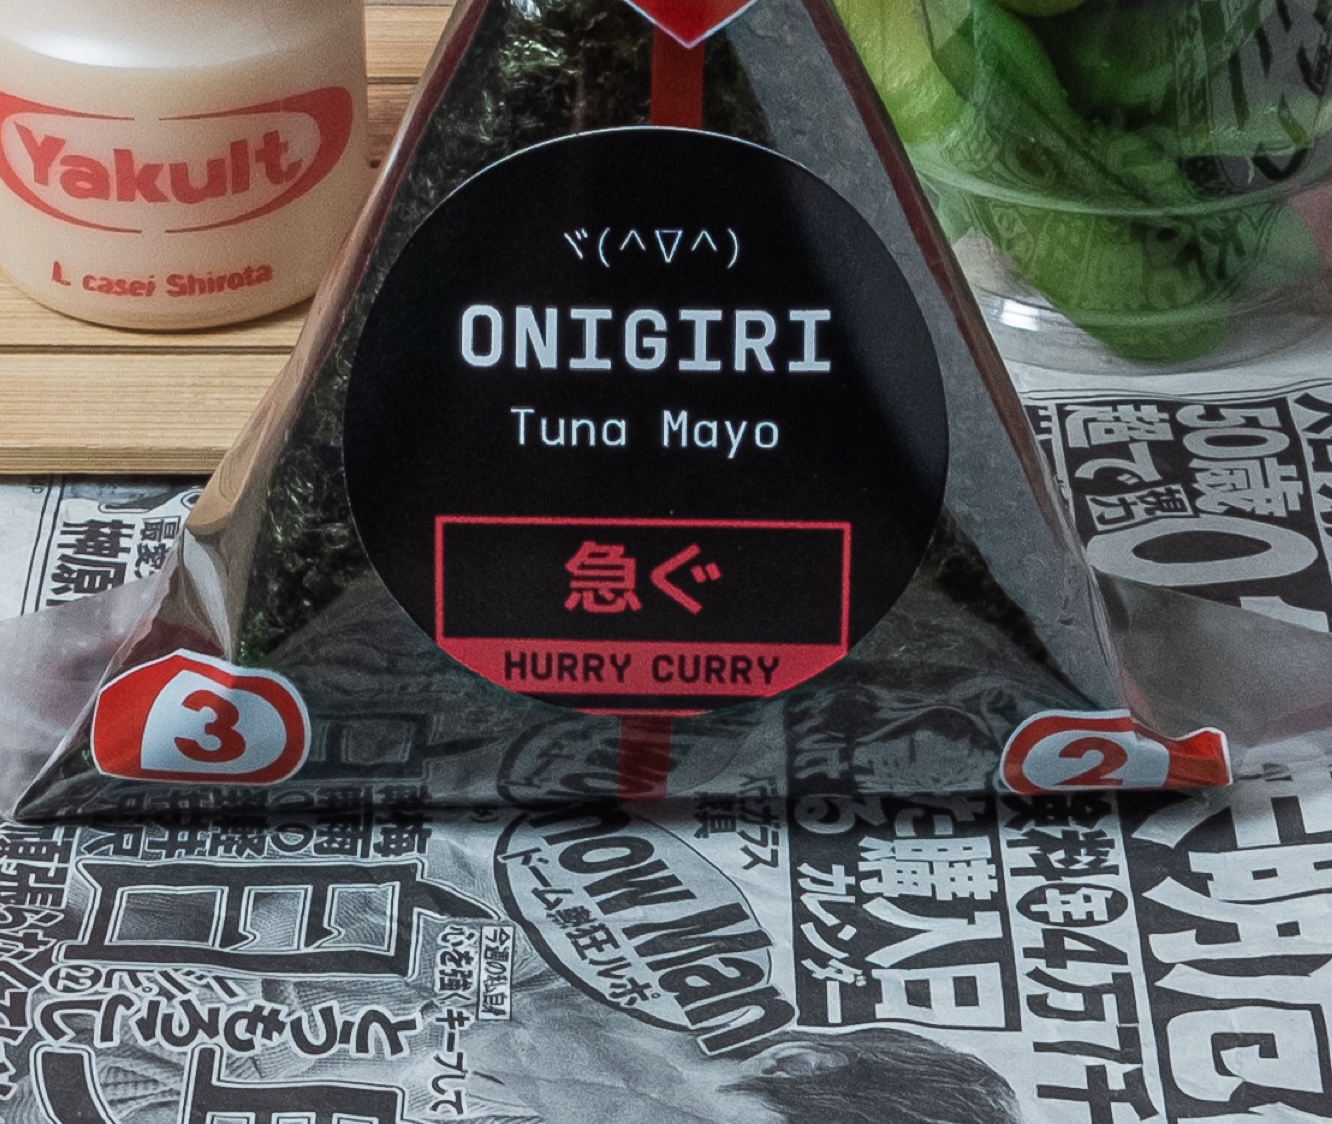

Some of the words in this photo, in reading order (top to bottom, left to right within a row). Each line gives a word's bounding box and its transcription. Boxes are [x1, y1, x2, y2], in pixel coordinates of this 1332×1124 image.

[13, 119, 303, 206] Yakult
[81, 274, 157, 298] casei
[167, 262, 274, 298] Shirota
[461, 304, 831, 372] ONIGIRI
[511, 408, 627, 447] Tuna
[662, 410, 779, 459] Mayo
[564, 541, 722, 616] 急ぐ
[504, 651, 633, 683] HURRY
[652, 655, 781, 686] CURRY
[174, 689, 246, 763] 3
[1057, 735, 1129, 787] 2
[621, 903, 796, 1056] Man
